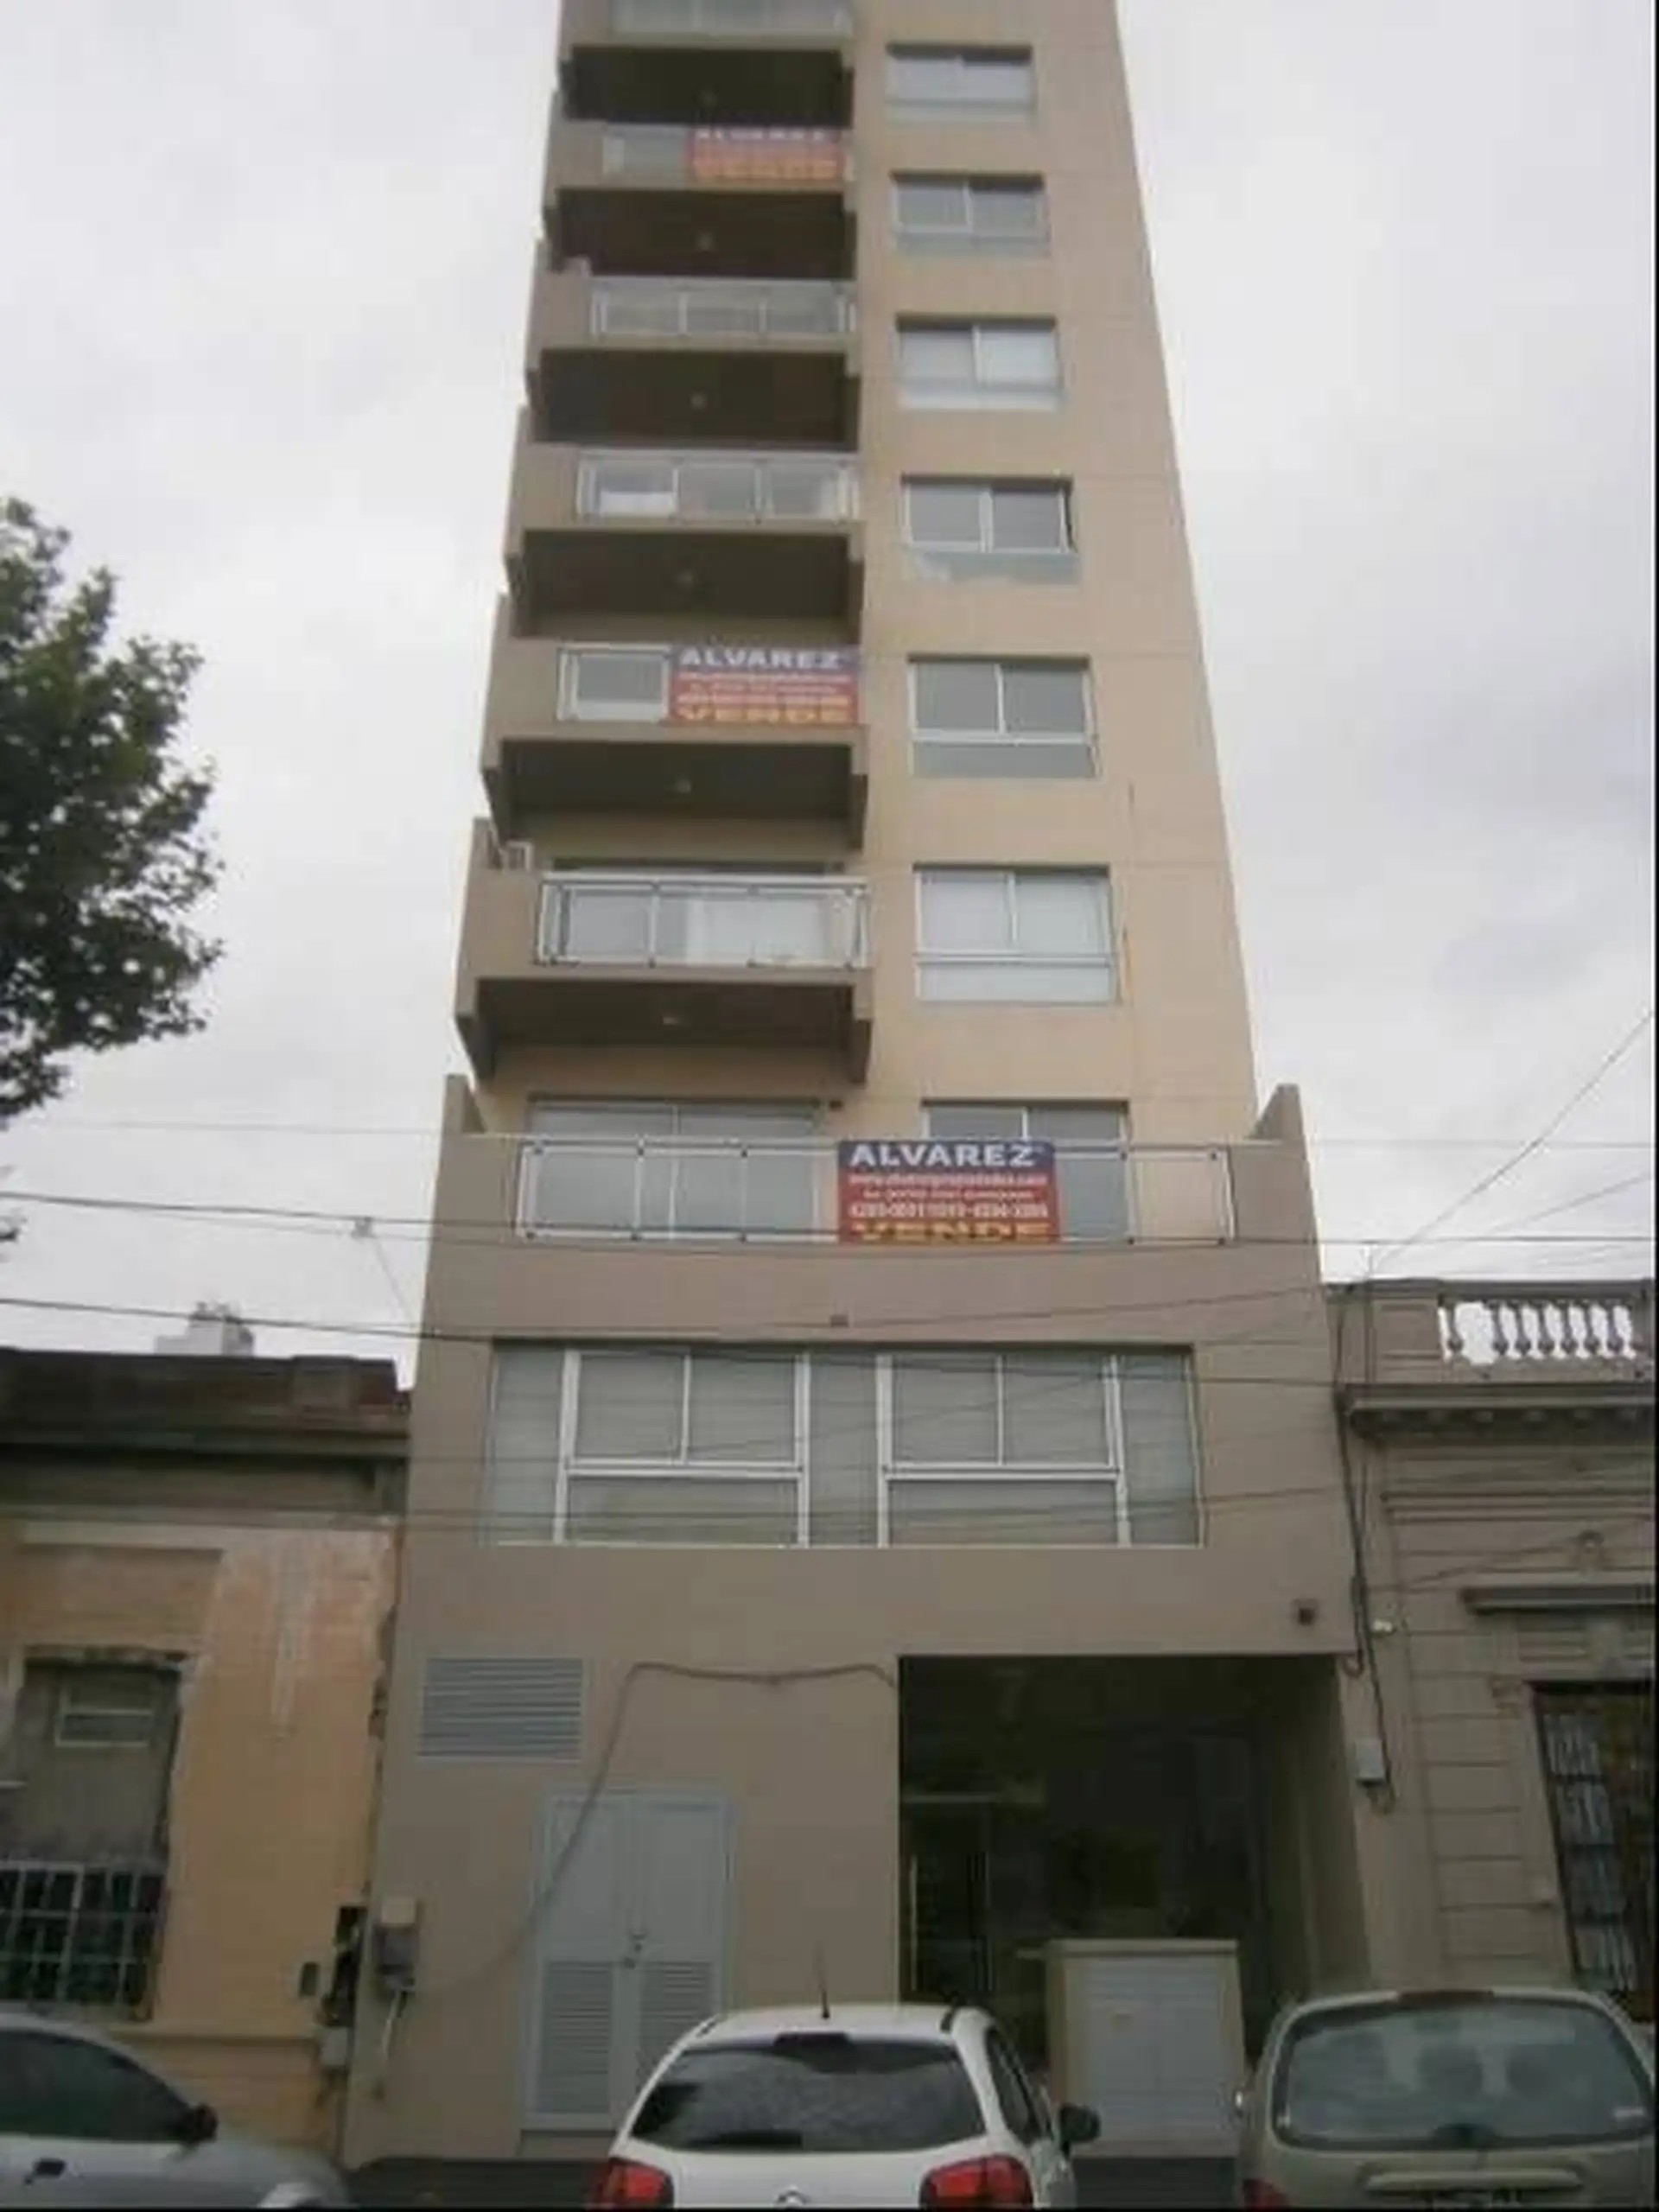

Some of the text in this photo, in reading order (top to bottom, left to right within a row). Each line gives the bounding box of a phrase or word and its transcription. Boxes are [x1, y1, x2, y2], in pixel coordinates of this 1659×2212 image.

[681, 647, 842, 669] ALVAREZ
[678, 707, 849, 725] VENDE
[849, 1143, 1036, 1167] ALVAREZ
[852, 1221, 1052, 1243] VENDE
